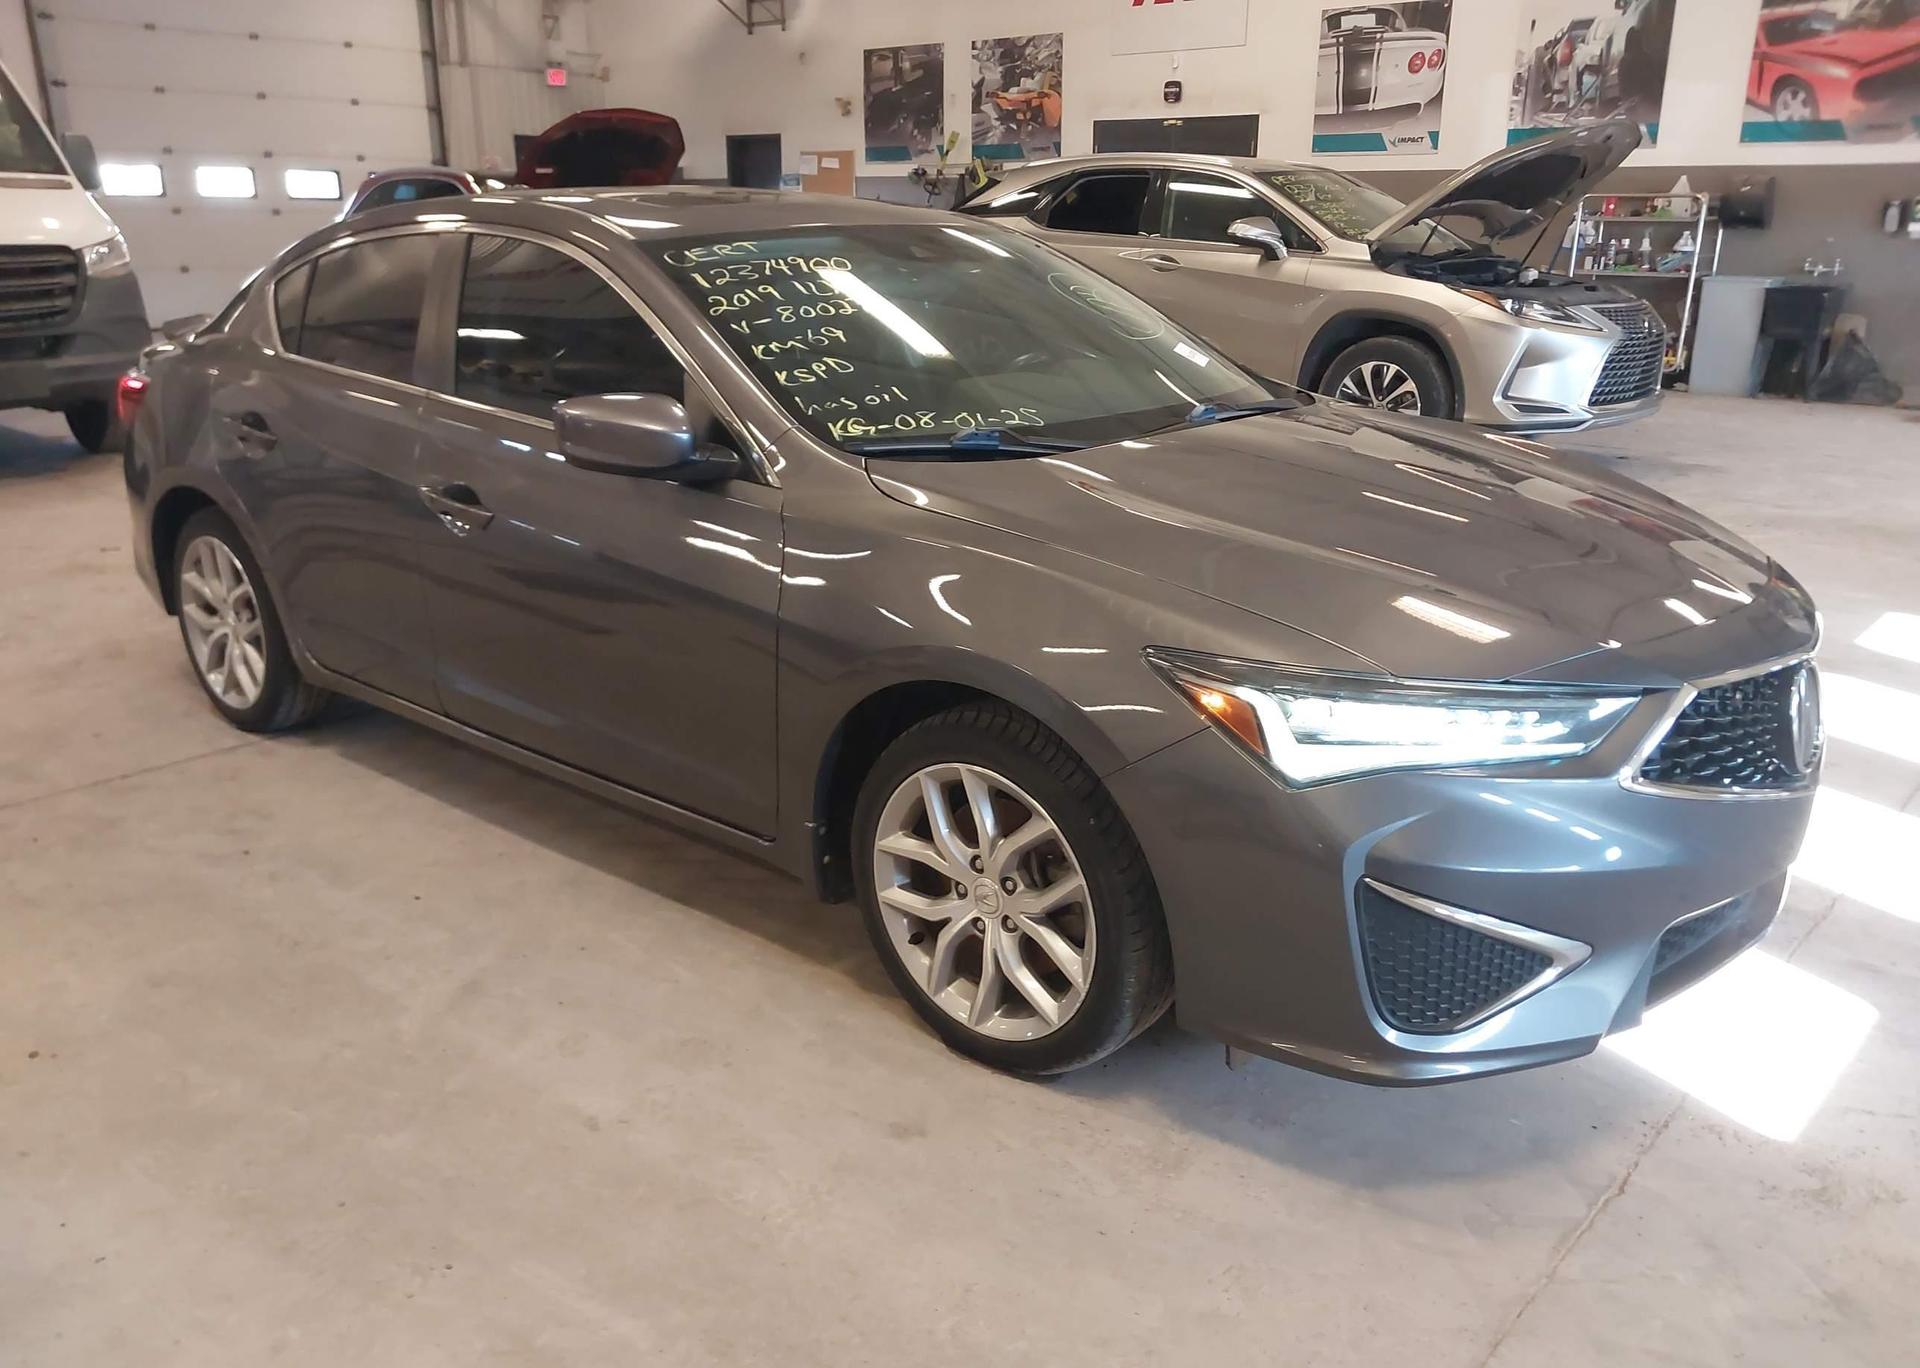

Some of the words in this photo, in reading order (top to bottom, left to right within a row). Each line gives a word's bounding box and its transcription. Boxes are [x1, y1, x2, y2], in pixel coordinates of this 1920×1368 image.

[663, 241, 760, 268] CERT
[690, 256, 853, 289] 12374900
[707, 285, 785, 317] 2019
[794, 396, 858, 416] has
[864, 384, 910, 406] oil
